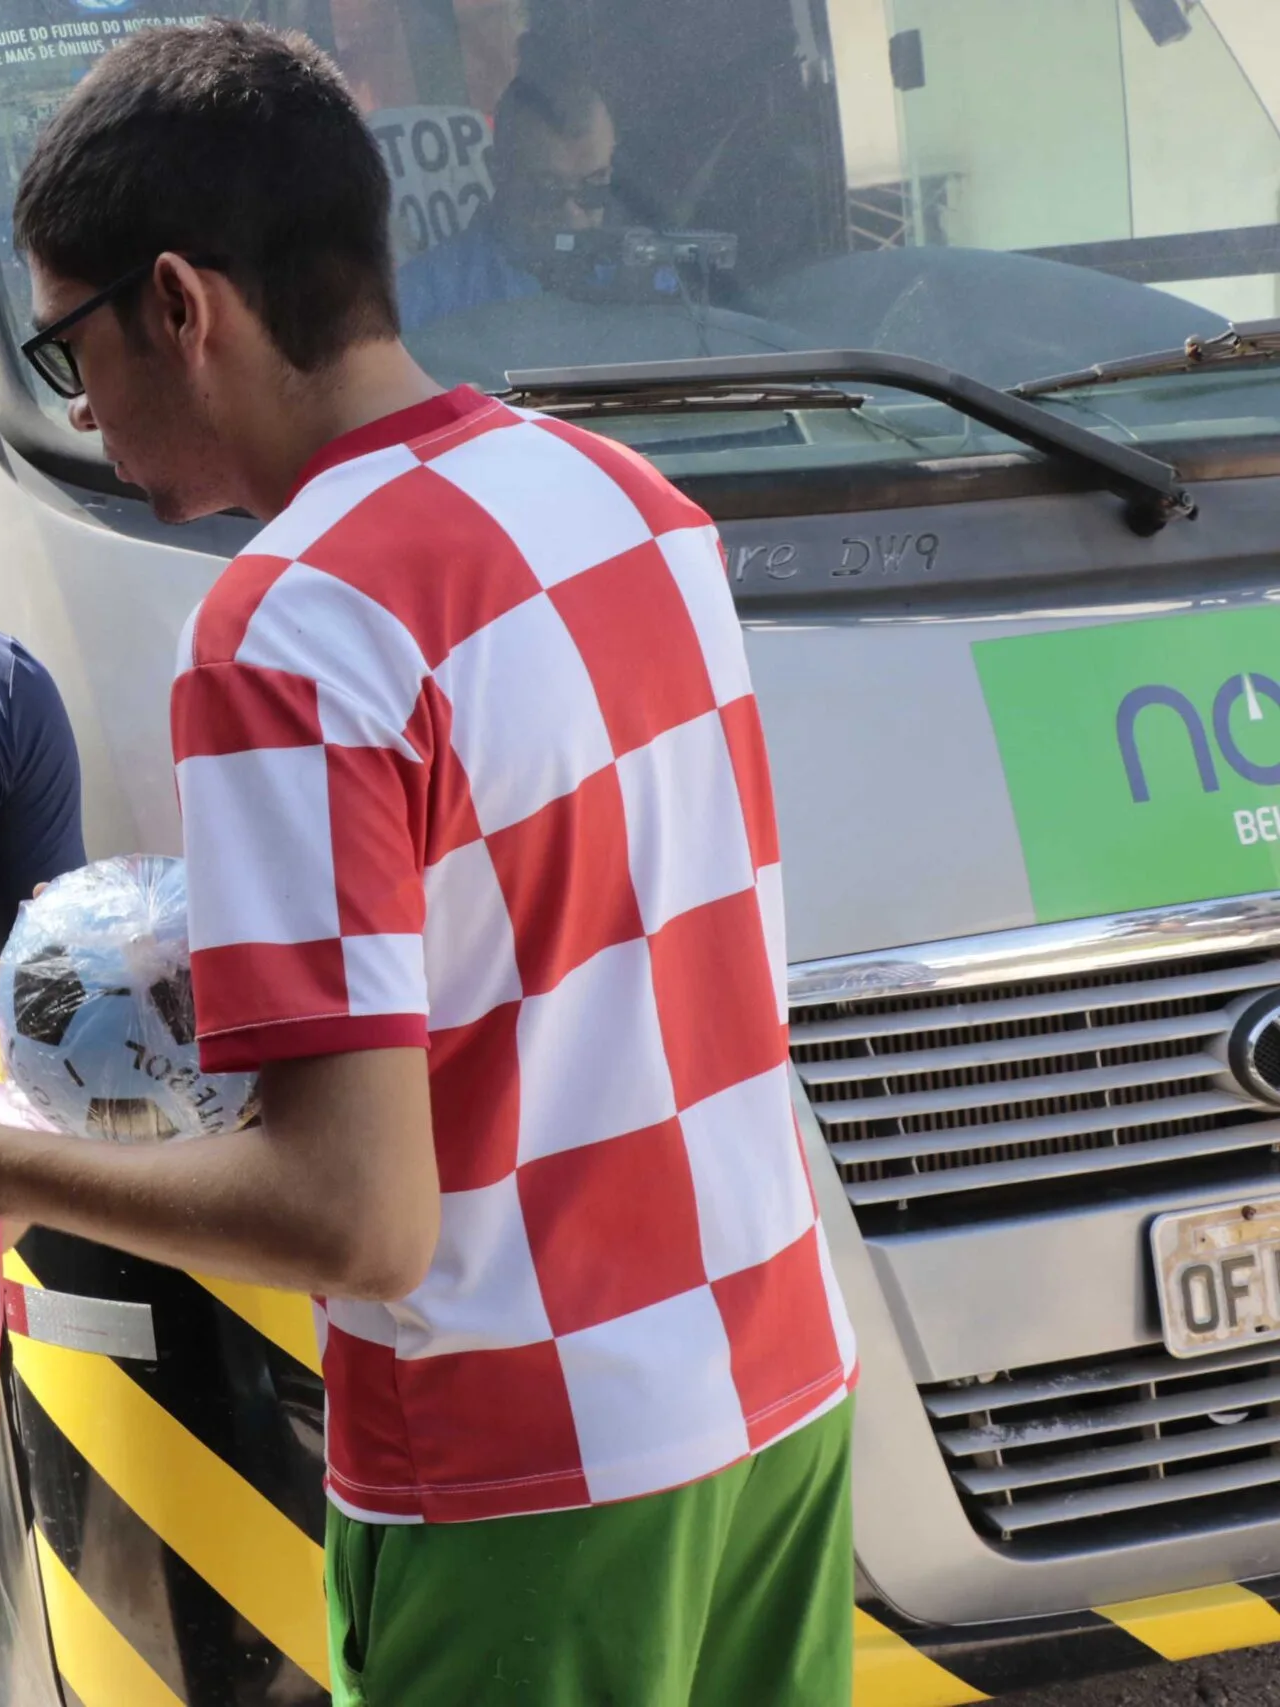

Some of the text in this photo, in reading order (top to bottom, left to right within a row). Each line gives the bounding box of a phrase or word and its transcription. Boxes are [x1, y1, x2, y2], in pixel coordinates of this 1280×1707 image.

[29, 26, 48, 41] DO
[51, 21, 100, 38] FUTURO
[102, 19, 121, 34] DO
[5, 48, 36, 64] MAIS
[40, 45, 57, 59] DE
[832, 533, 939, 577] DW9
[1181, 1249, 1280, 1334] OF
